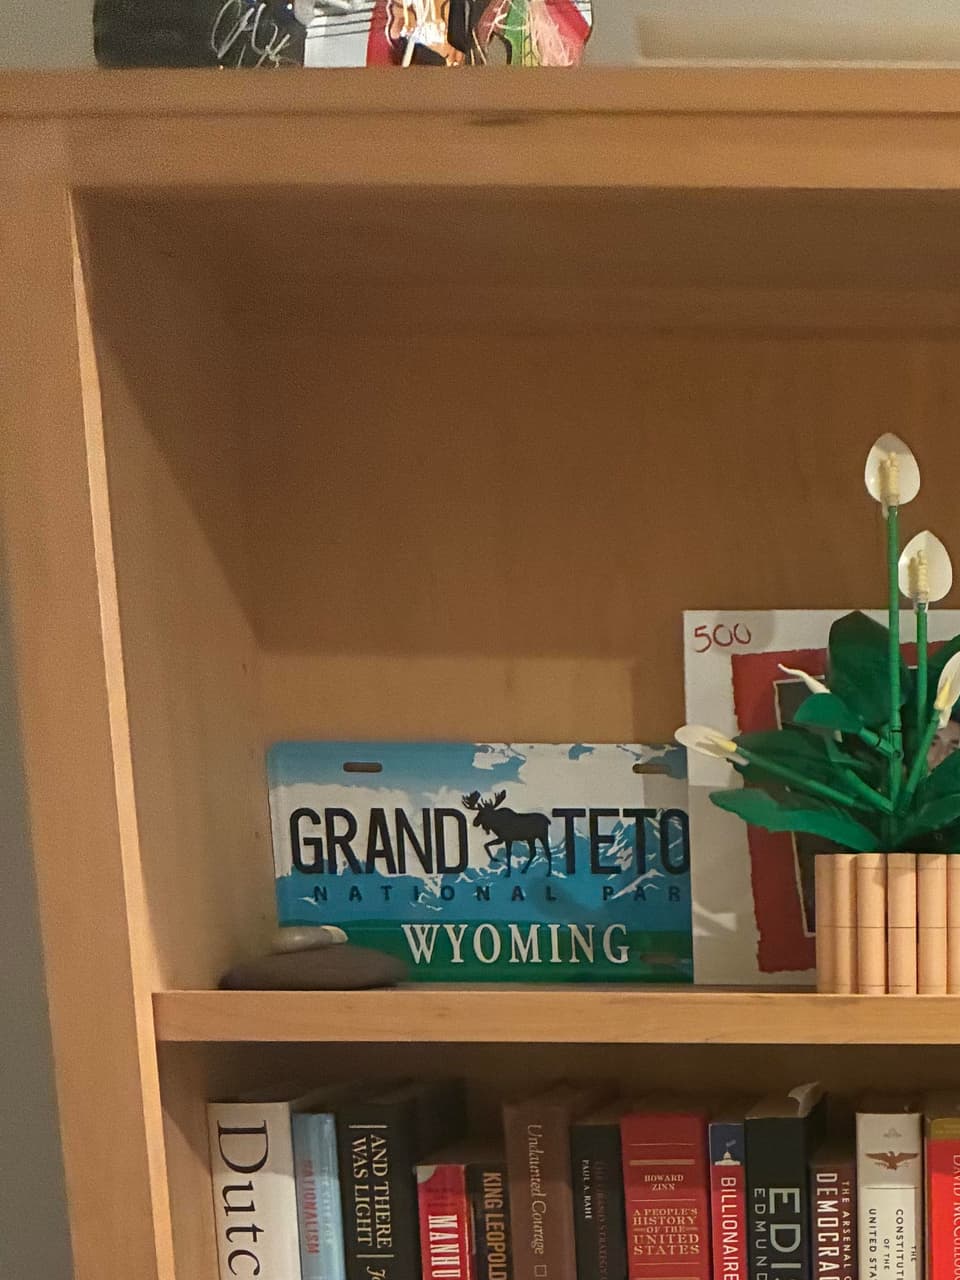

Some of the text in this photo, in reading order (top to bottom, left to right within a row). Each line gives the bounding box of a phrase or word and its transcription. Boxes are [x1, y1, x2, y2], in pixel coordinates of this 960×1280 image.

[694, 624, 752, 652] 500
[290, 807, 468, 874] GRAND
[313, 885, 556, 901] NATIONAL
[402, 924, 630, 964] WYOMING
[351, 1137, 372, 1247] WAS LIGHT
[370, 1134, 393, 1250] AND THERE
[483, 1171, 502, 1210] KING
[527, 1124, 545, 1254] Undaunted Courage
[644, 1174, 684, 1182] HOWARD
[841, 1181, 850, 1205] THE
[633, 1216, 695, 1225] HISTORY
[644, 1208, 698, 1216] PEOPLE'S
[634, 1234, 699, 1244] UNITED
[842, 1210, 852, 1270] ARSENAL
[868, 1209, 877, 1252] UNITED
[634, 1244, 699, 1255] STATES
